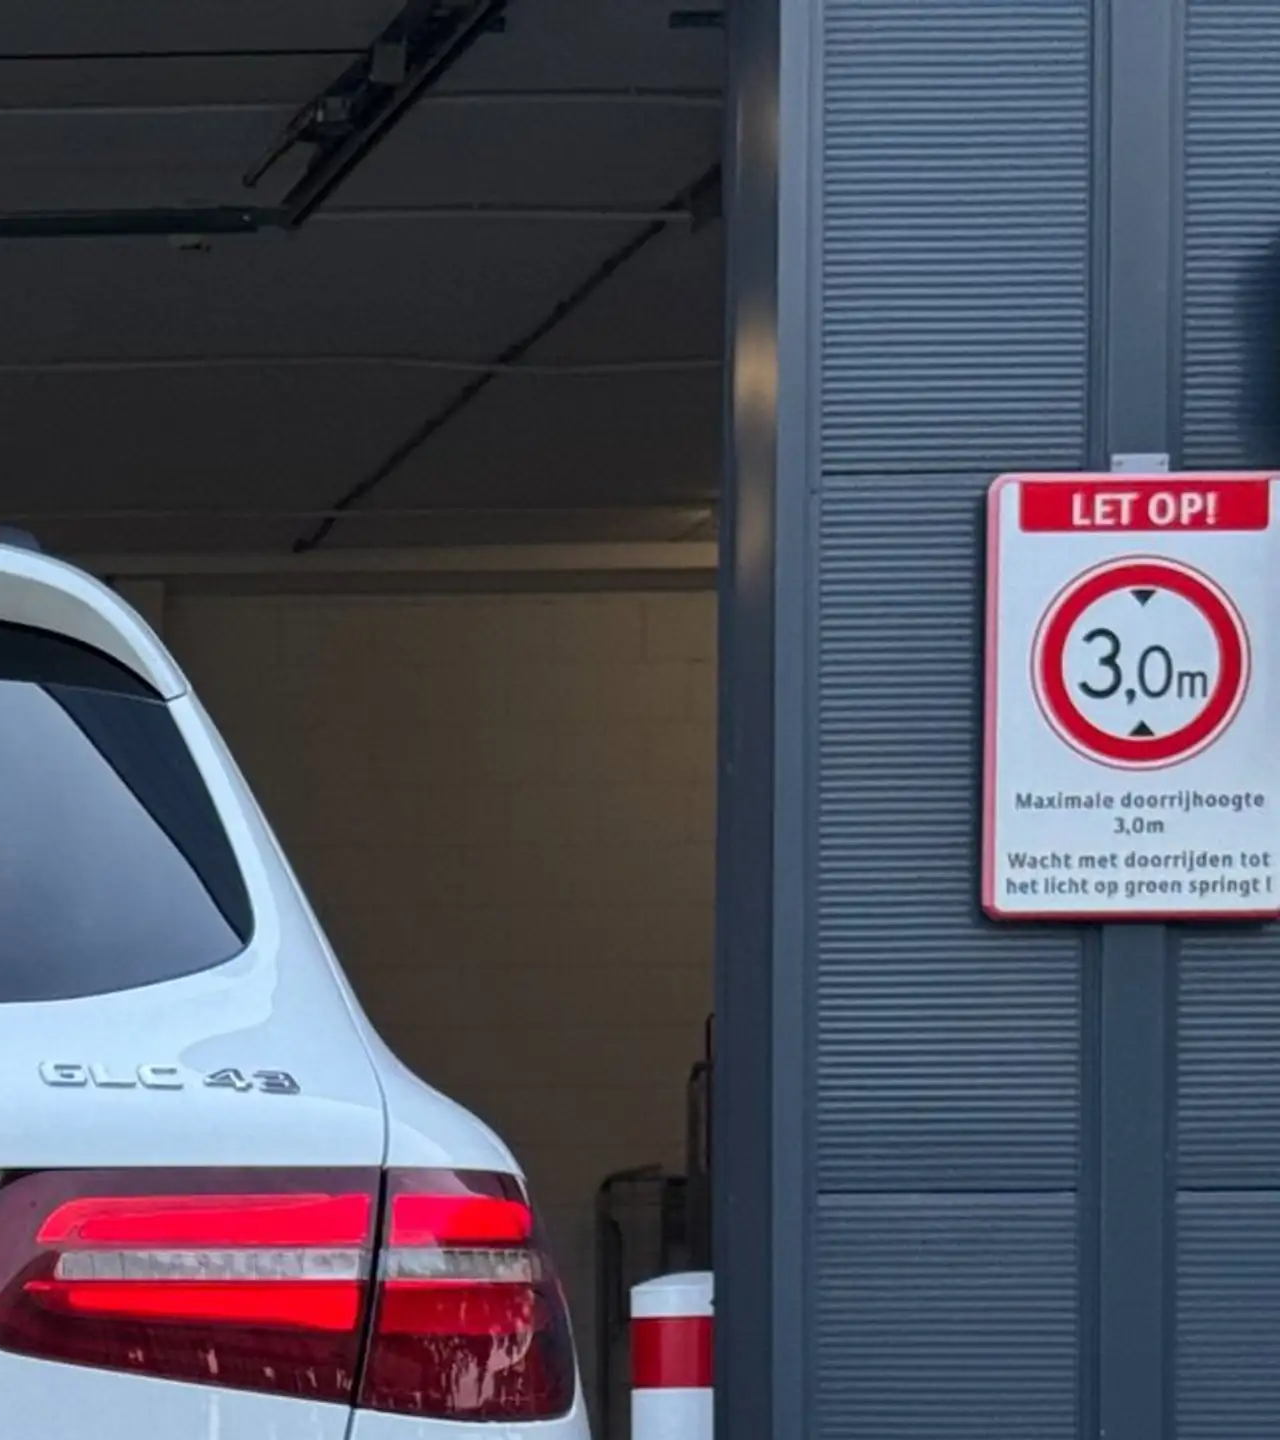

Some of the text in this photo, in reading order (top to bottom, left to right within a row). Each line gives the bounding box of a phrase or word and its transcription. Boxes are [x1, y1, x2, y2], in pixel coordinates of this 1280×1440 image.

[1072, 491, 1218, 526] LET OP!
[1078, 627, 1209, 705] 3,0m
[1015, 789, 1265, 811] Maximale doorrijhoogte
[1113, 816, 1165, 835] 3,0m
[1007, 851, 1271, 871] Wacht met doorrijden tot
[1005, 878, 1037, 895] het
[1043, 877, 1088, 894] licht
[1094, 882, 1119, 899] op
[1124, 882, 1182, 898] groen
[1189, 876, 1260, 898] springt
[39, 1061, 301, 1096] GLC 43
